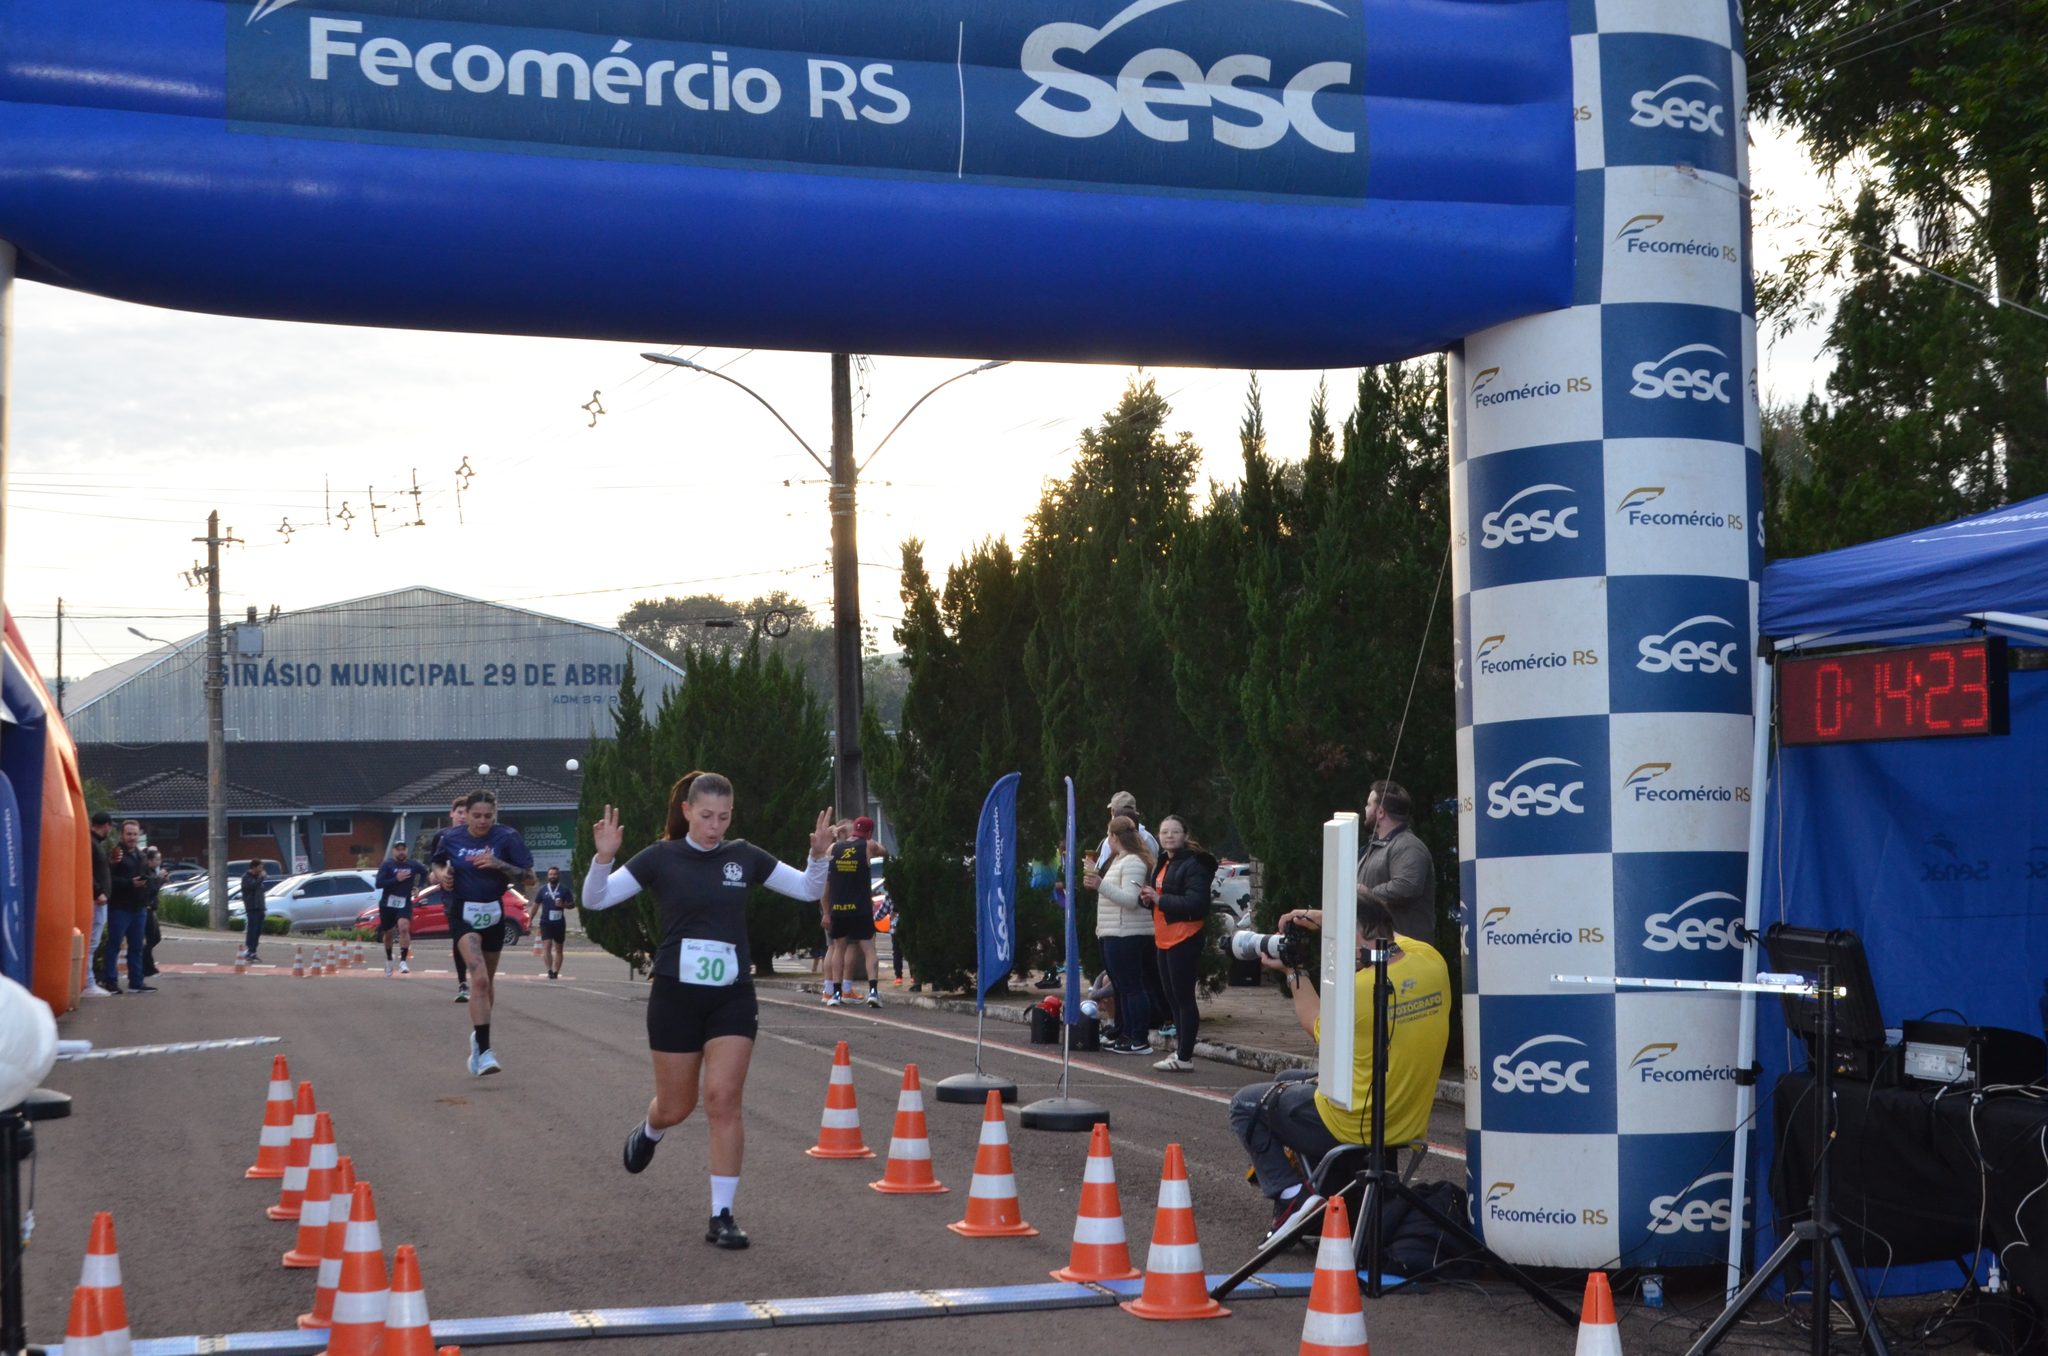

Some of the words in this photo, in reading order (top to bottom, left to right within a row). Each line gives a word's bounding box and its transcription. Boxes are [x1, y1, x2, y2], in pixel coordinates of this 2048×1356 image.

[309, 17, 781, 114] Fecomércio
[809, 59, 911, 124] RS
[1015, 22, 1355, 153] Sesc
[1630, 89, 1724, 137] Sesc
[1628, 238, 1719, 258] Fecomércio
[1722, 245, 1737, 262] RS
[1476, 382, 1560, 409] Fecomércio
[1567, 377, 1592, 393] RS
[1630, 361, 1730, 403] Sesc
[1481, 506, 1578, 549] Sesc
[1629, 510, 1724, 528] Fecomércio
[1728, 514, 1743, 531] RS
[1481, 653, 1567, 675] Fecomércio
[1573, 650, 1598, 666] RS
[1636, 635, 1738, 675] Sesc
[330, 663, 474, 687] MUNICIPAL
[484, 664, 517, 687] 29
[524, 664, 556, 687] DE
[1486, 781, 1584, 819] Sesc
[1635, 785, 1731, 802] Fecomércio
[1735, 786, 1751, 802] RS
[473, 912, 492, 927] 29
[833, 903, 857, 911] ATLETA
[1486, 928, 1572, 946] Fecomércio
[1579, 927, 1604, 943] RS
[1642, 913, 1745, 952] Sesc
[695, 956, 725, 982] 30
[1492, 1055, 1590, 1094] Sesc
[1641, 1065, 1738, 1083] Fecomércio
[1491, 1205, 1576, 1225] Fecomércio
[1583, 1209, 1608, 1225] RS
